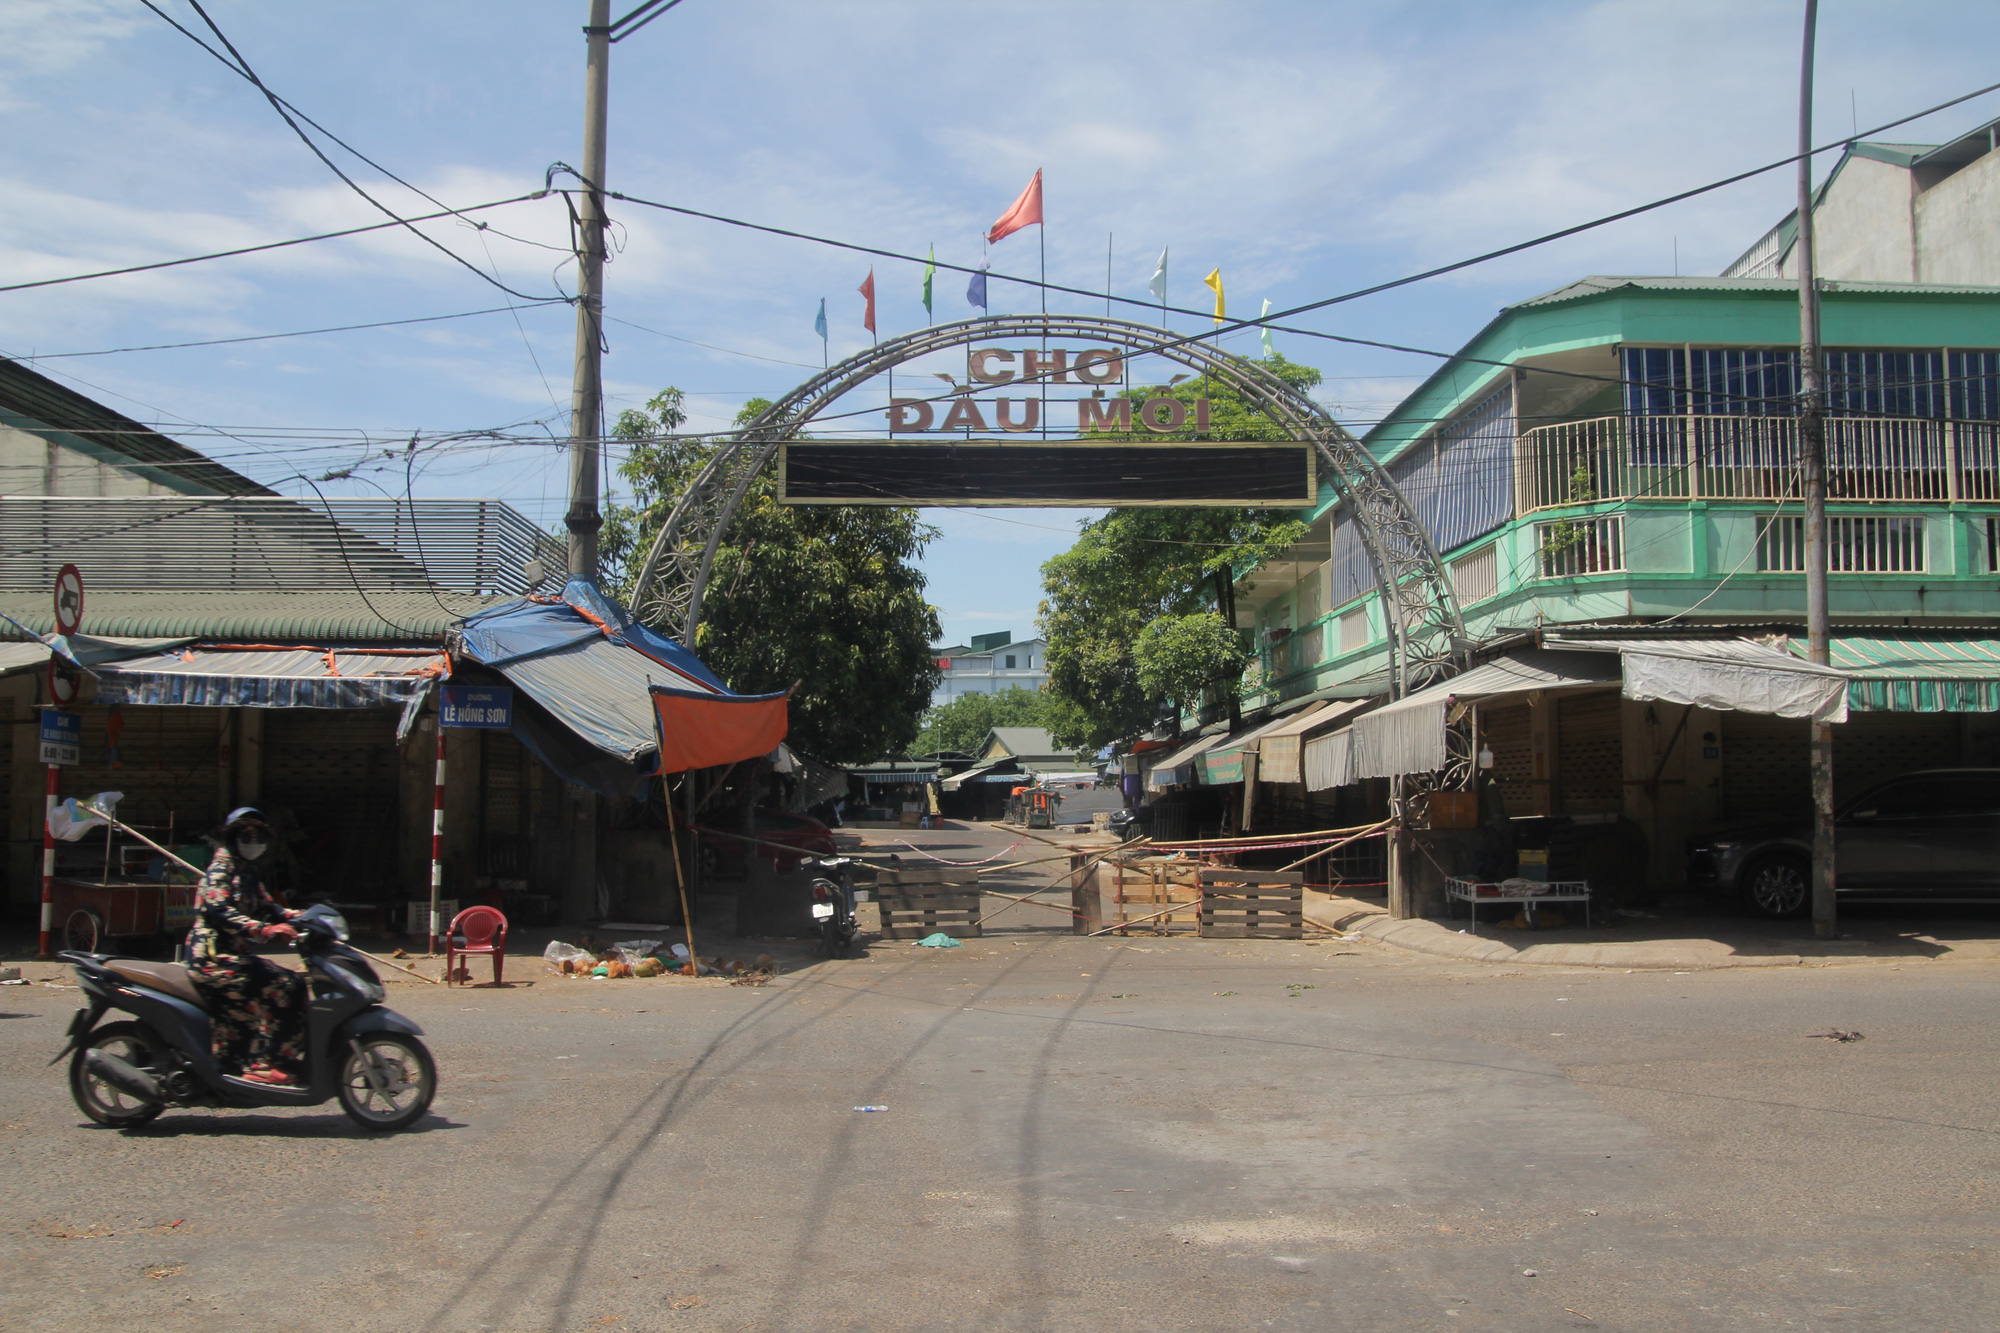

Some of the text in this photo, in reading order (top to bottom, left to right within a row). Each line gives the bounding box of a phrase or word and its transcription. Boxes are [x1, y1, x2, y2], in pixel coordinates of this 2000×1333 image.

[968, 347, 1124, 397] CHỢ
[885, 373, 1211, 433] ĐẦU MỐI
[444, 702, 506, 723] LÊ HỒNG SƠN
